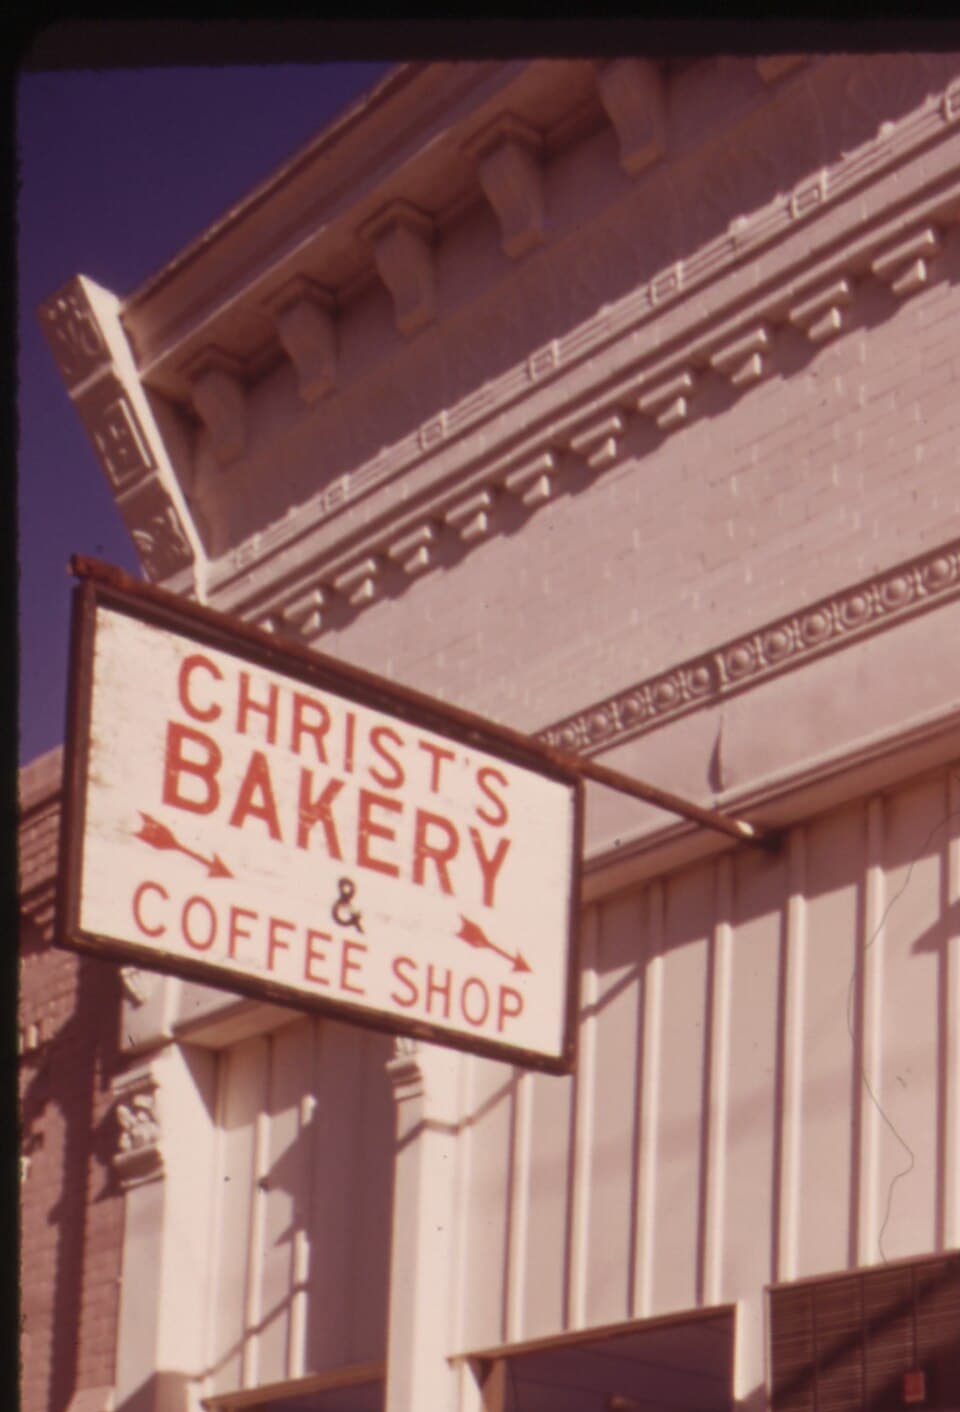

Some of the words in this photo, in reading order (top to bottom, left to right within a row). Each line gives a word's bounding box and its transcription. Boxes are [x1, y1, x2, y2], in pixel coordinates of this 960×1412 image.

[161, 719, 512, 908] BAKERY
[177, 653, 509, 829] CHRIST'S
[131, 880, 368, 996] COFFEE
[391, 955, 524, 1033] SHOP
[331, 876, 364, 934] &
